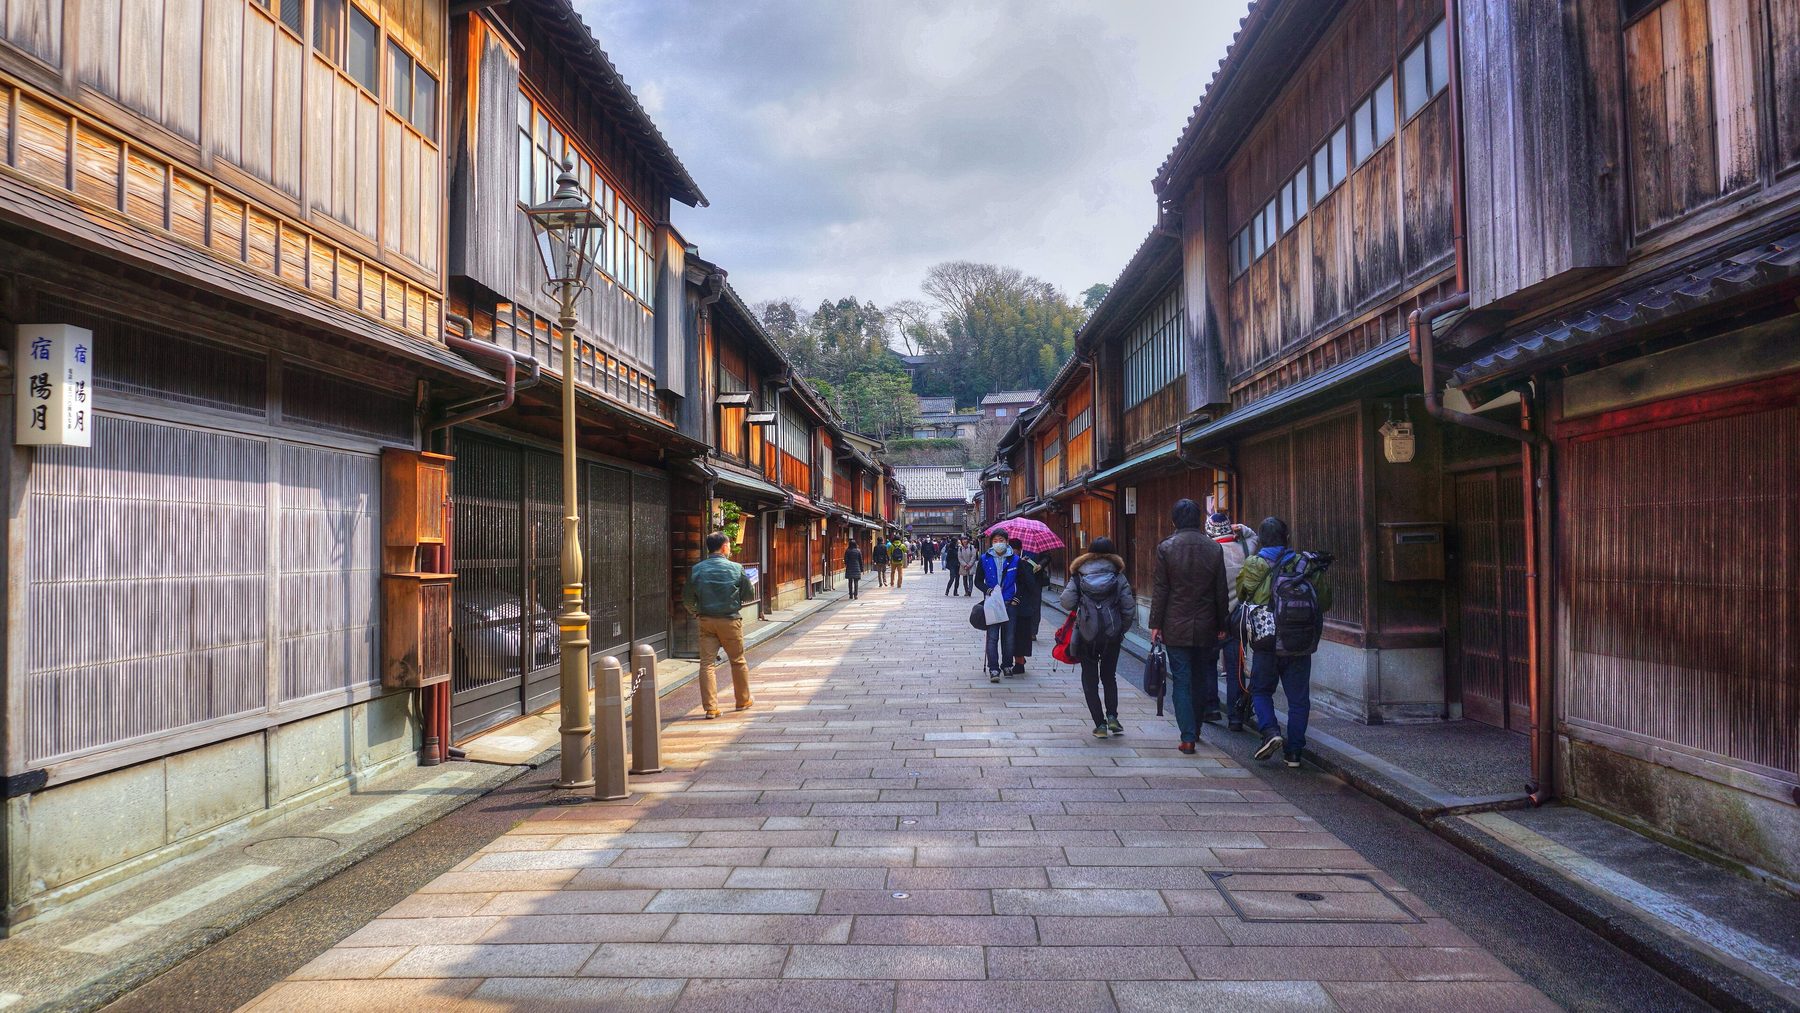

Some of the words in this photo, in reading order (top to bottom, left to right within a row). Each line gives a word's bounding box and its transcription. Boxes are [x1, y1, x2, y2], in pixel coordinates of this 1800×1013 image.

[29, 336, 53, 431] 宿陽月
[74, 344, 88, 432] 宿陽月
